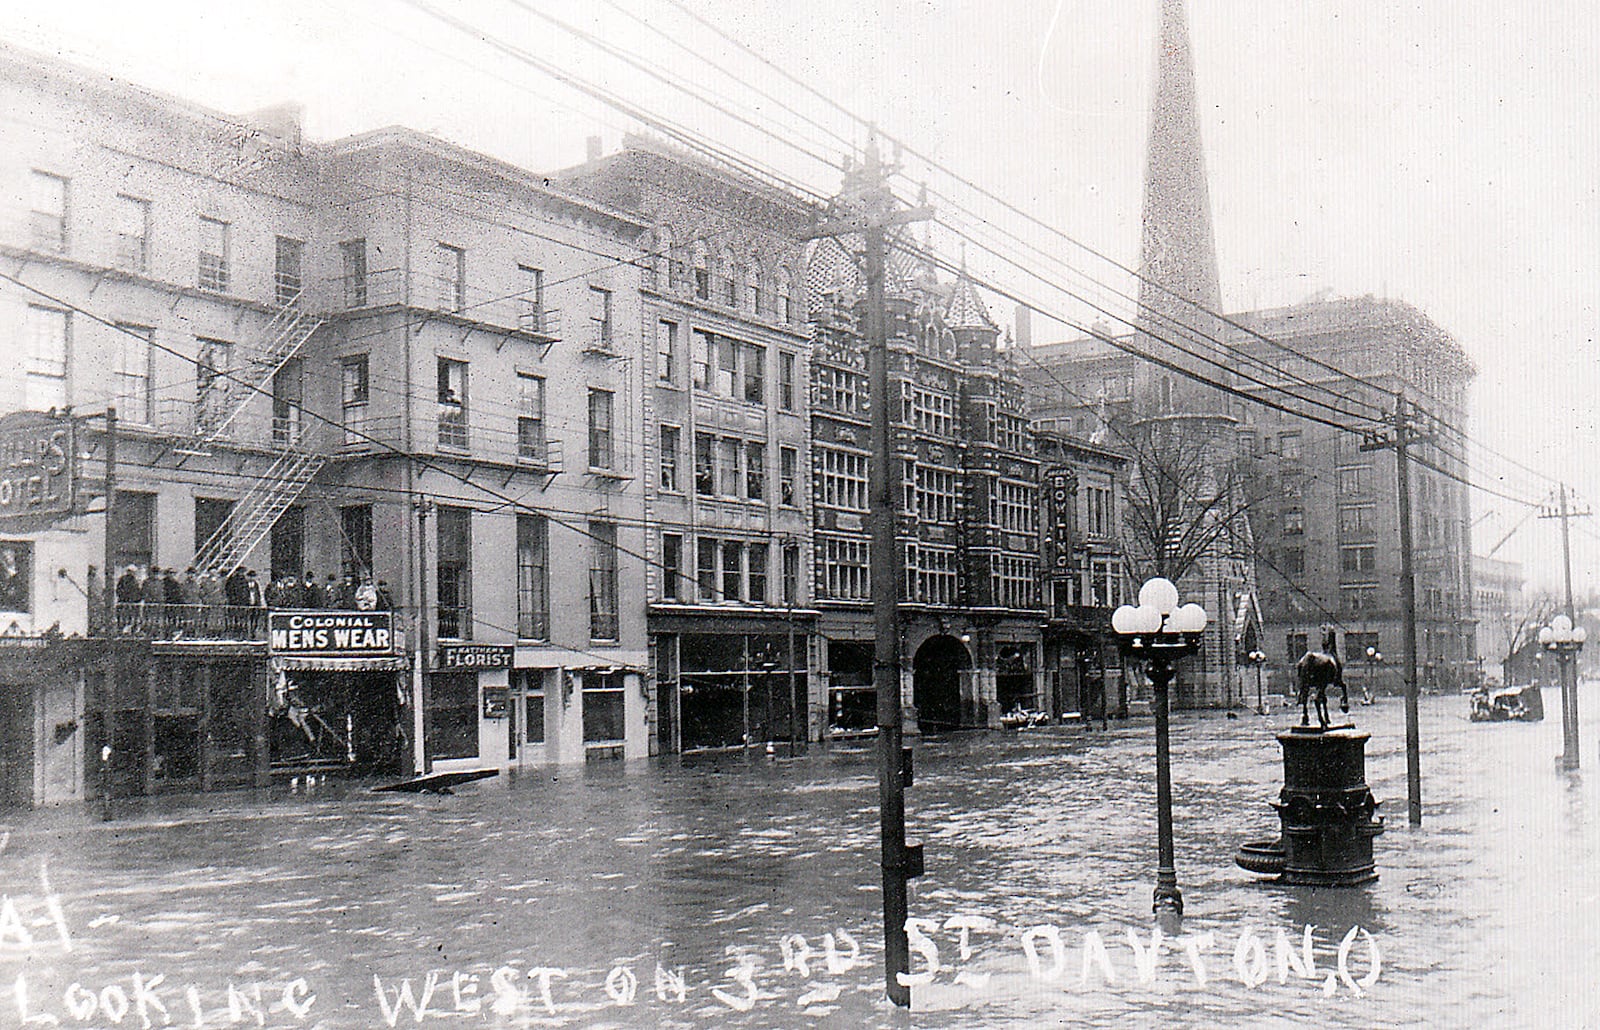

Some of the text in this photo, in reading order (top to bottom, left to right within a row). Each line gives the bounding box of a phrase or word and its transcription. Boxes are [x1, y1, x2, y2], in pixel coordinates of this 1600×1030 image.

[1054, 476, 1068, 568] BOWLING
[290, 616, 373, 629] COLONIAL
[272, 628, 389, 649] MENS WEAR
[447, 648, 511, 666] FLORIST
